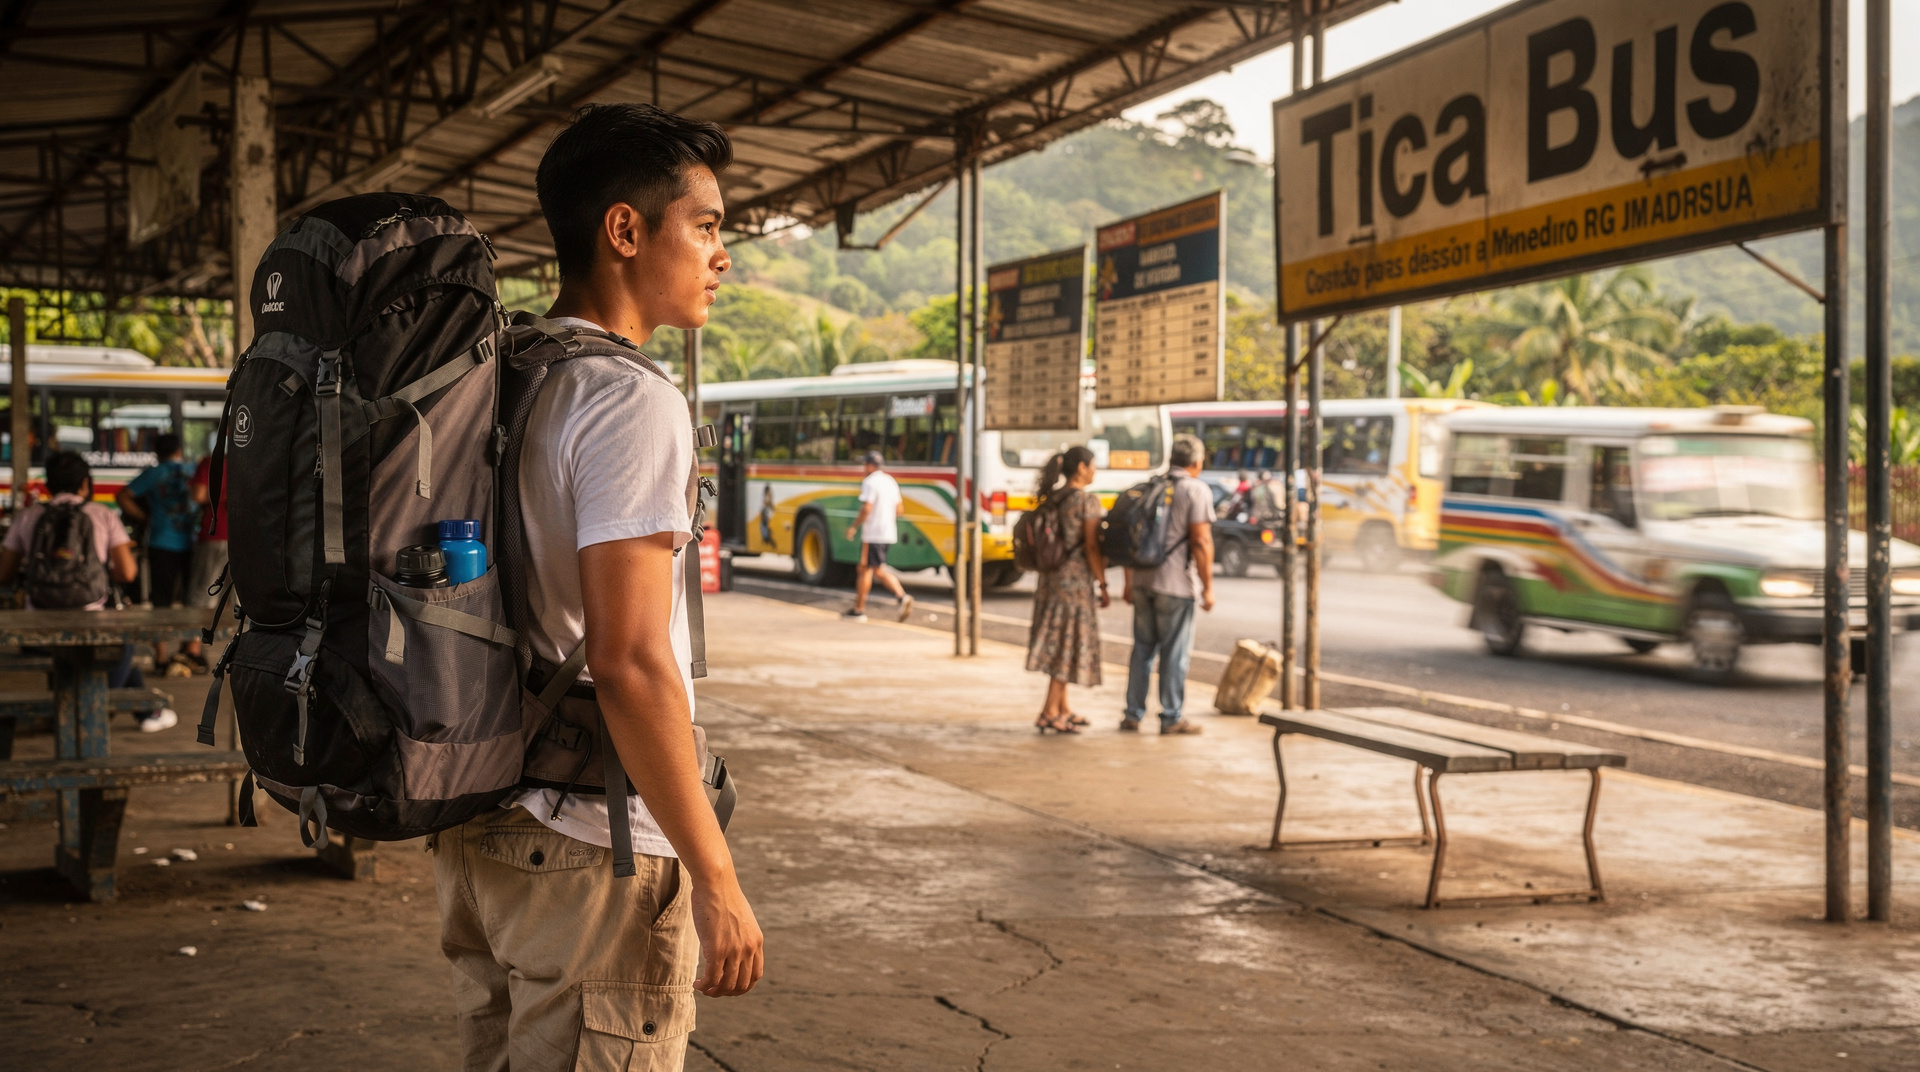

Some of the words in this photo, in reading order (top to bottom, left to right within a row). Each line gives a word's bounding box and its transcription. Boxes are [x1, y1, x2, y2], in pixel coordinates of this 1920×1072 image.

[1302, 93, 1489, 239] Tica
[1527, 1, 1760, 184] Bus
[1584, 204, 1616, 240] RG
